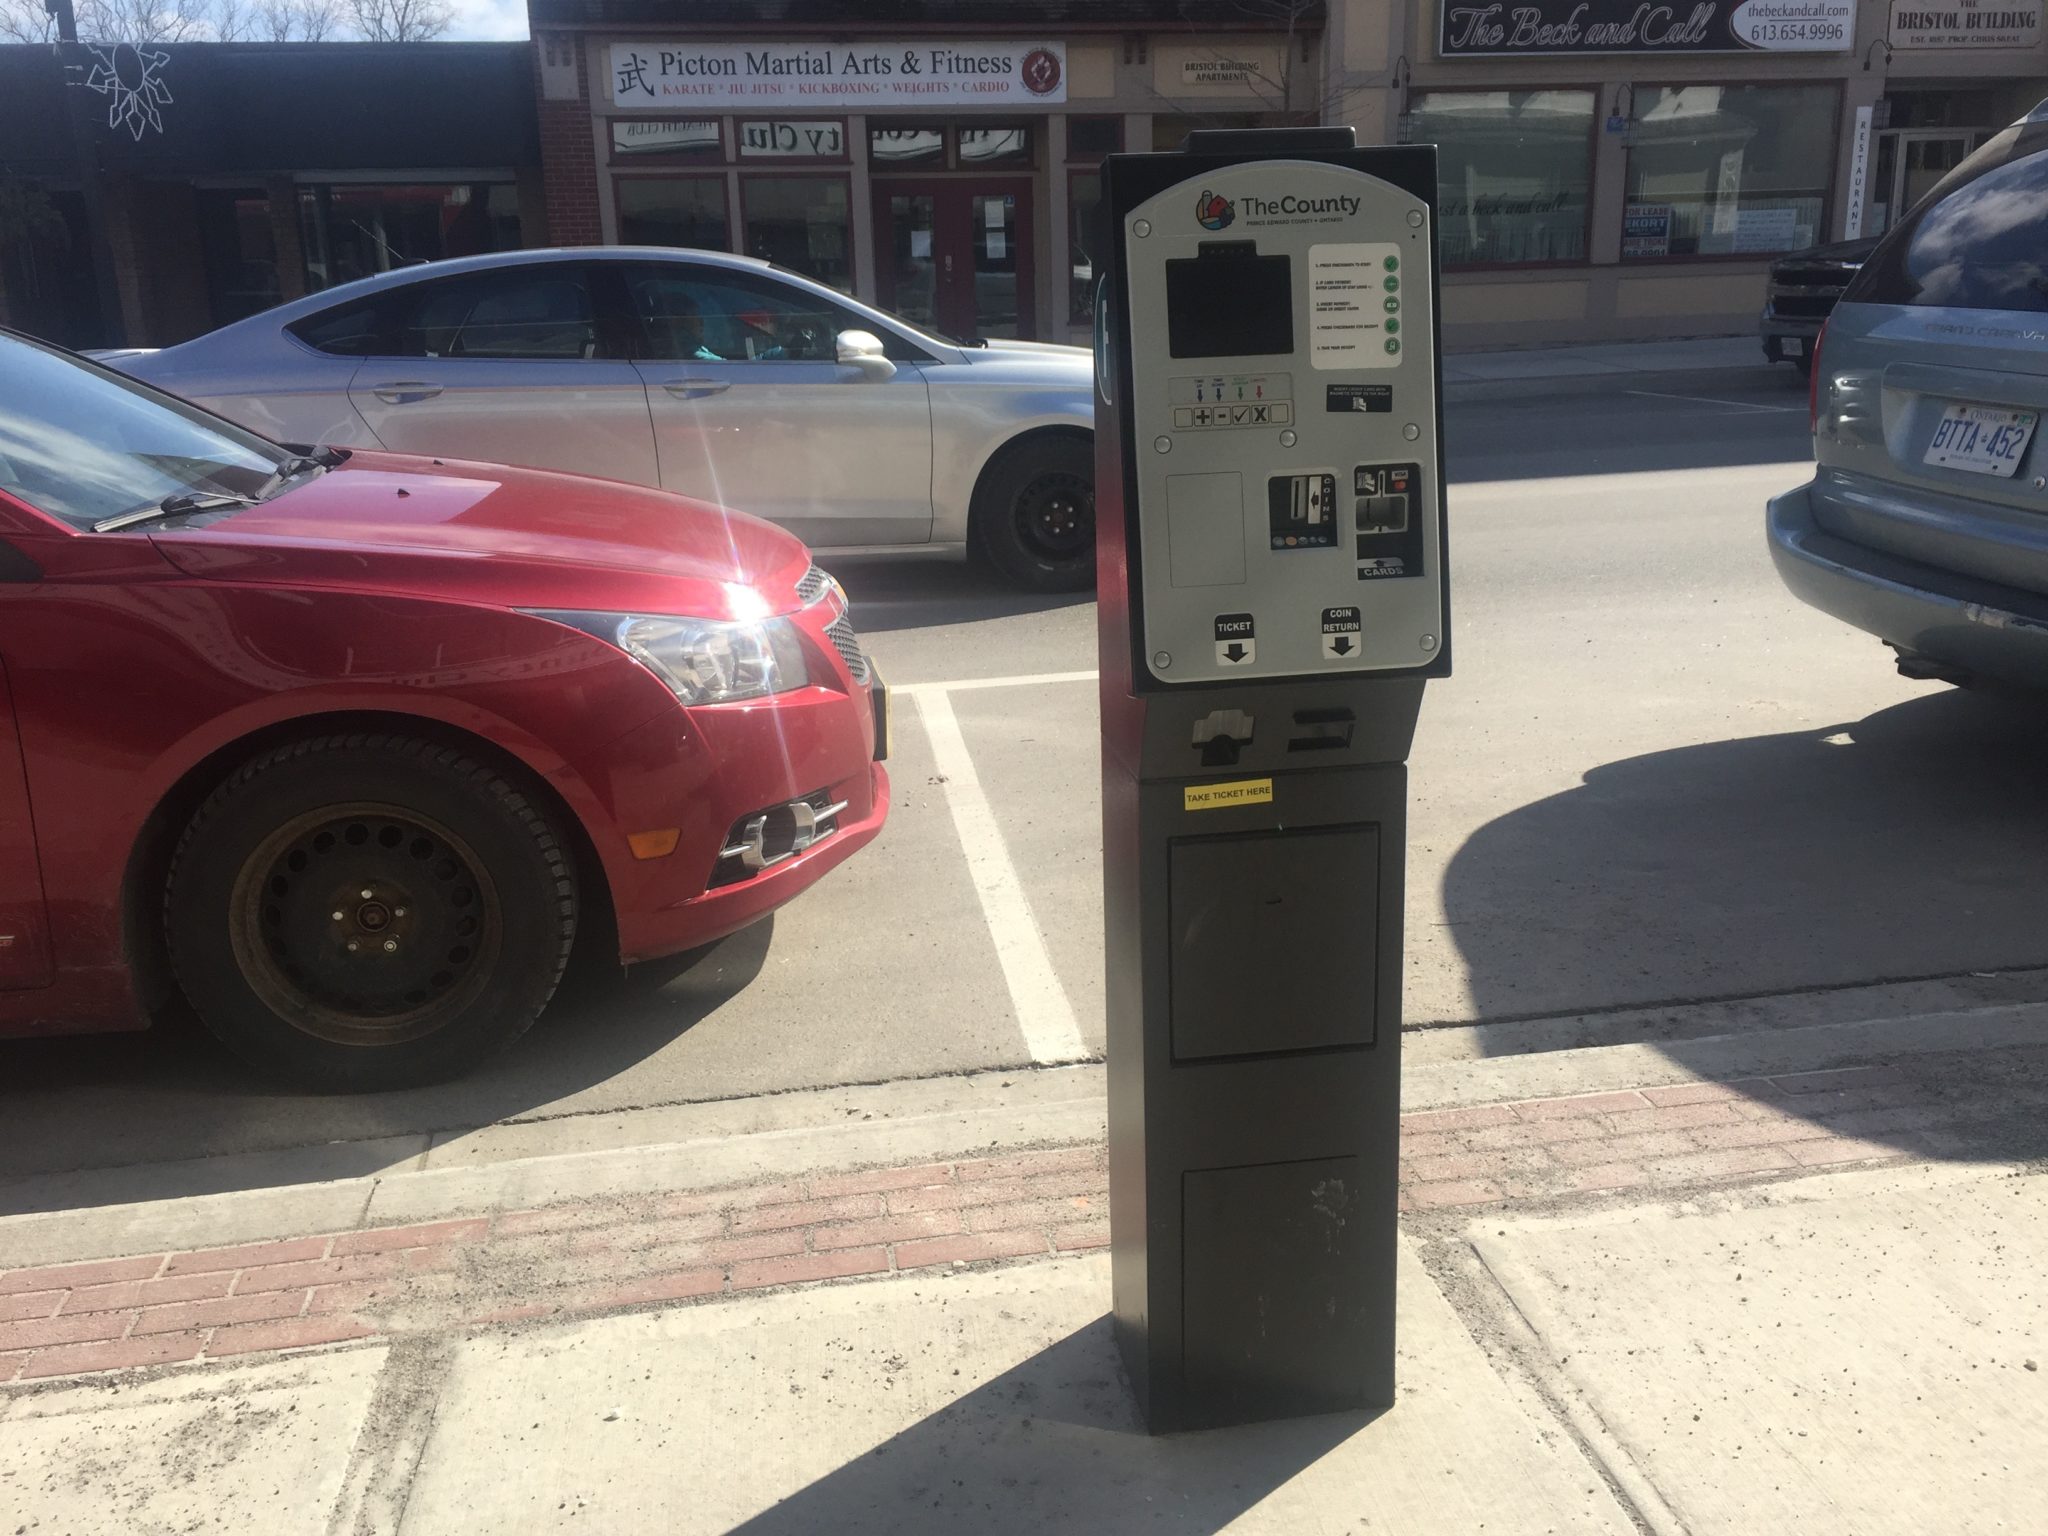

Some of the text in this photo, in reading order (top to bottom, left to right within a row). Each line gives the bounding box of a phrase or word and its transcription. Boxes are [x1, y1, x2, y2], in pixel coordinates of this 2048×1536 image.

[1748, 3, 1849, 17] thebeckandcall.com
[1450, 2, 1717, 48] The Beck and Call
[1897, 11, 2036, 30] BRISTOL BUILDING
[1751, 24, 1843, 40] 613.654.9996
[659, 51, 737, 76] Picton
[745, 50, 833, 76] Martial
[841, 50, 892, 75] Arts
[900, 50, 922, 75] &
[930, 50, 1013, 74] Fitness
[1185, 62, 1217, 71] BRISTOL
[617, 52, 655, 96] 武
[1195, 72, 1249, 81] APARTMENTS
[663, 83, 715, 96] KARATE
[728, 83, 746, 95] JIU
[751, 82, 785, 95] JITSU
[799, 81, 880, 95] KICKBOXING
[893, 81, 950, 94] WEIGHTS
[962, 80, 1010, 93] CARDIO
[1850, 120, 1867, 231] RESTAURANT
[1241, 194, 1361, 216] TheCounty
[1322, 477, 1333, 522] COINS
[1363, 566, 1404, 577] CARDS
[1329, 609, 1352, 618] COIN
[1217, 621, 1251, 632] TICKET
[1323, 622, 1360, 632] RETURN
[1187, 786, 1271, 803] TAKE TICKET HERE
